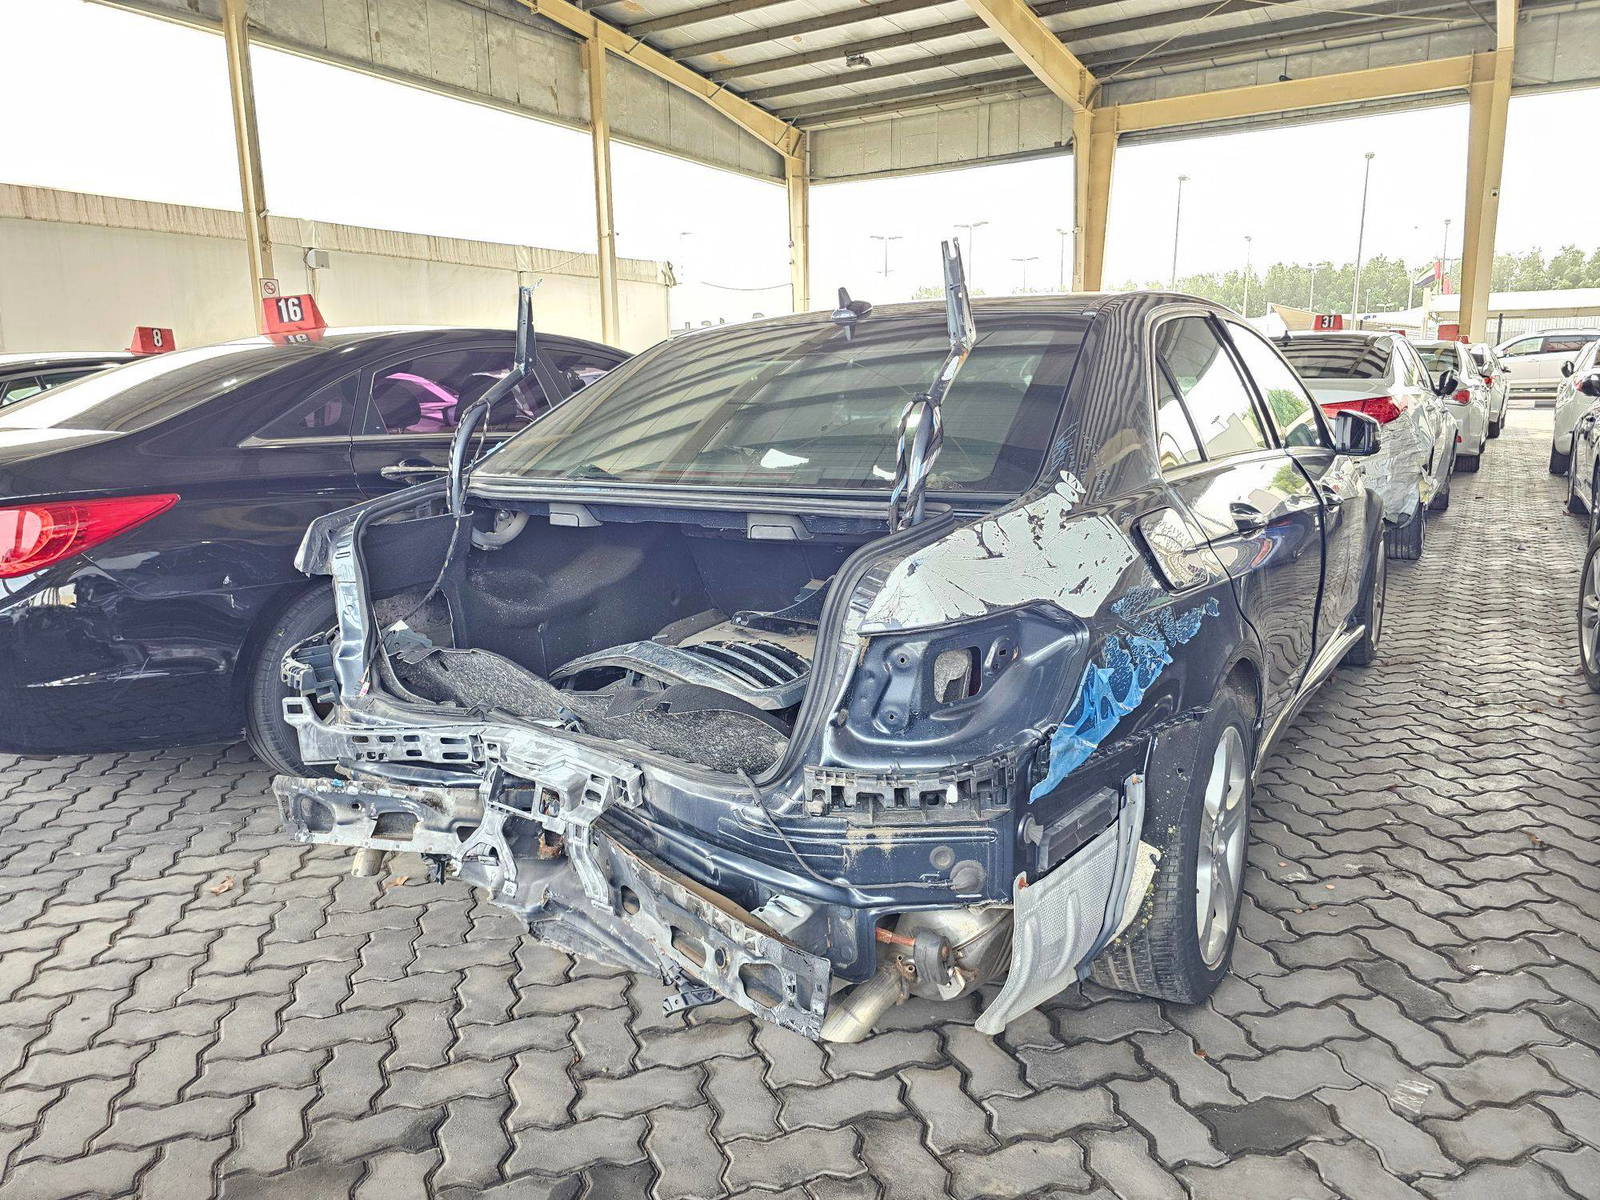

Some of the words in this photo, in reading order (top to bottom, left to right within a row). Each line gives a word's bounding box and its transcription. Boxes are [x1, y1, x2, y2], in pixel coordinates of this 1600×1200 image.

[278, 297, 302, 323] 16
[1321, 315, 1335, 328] 31
[152, 328, 163, 347] 8
